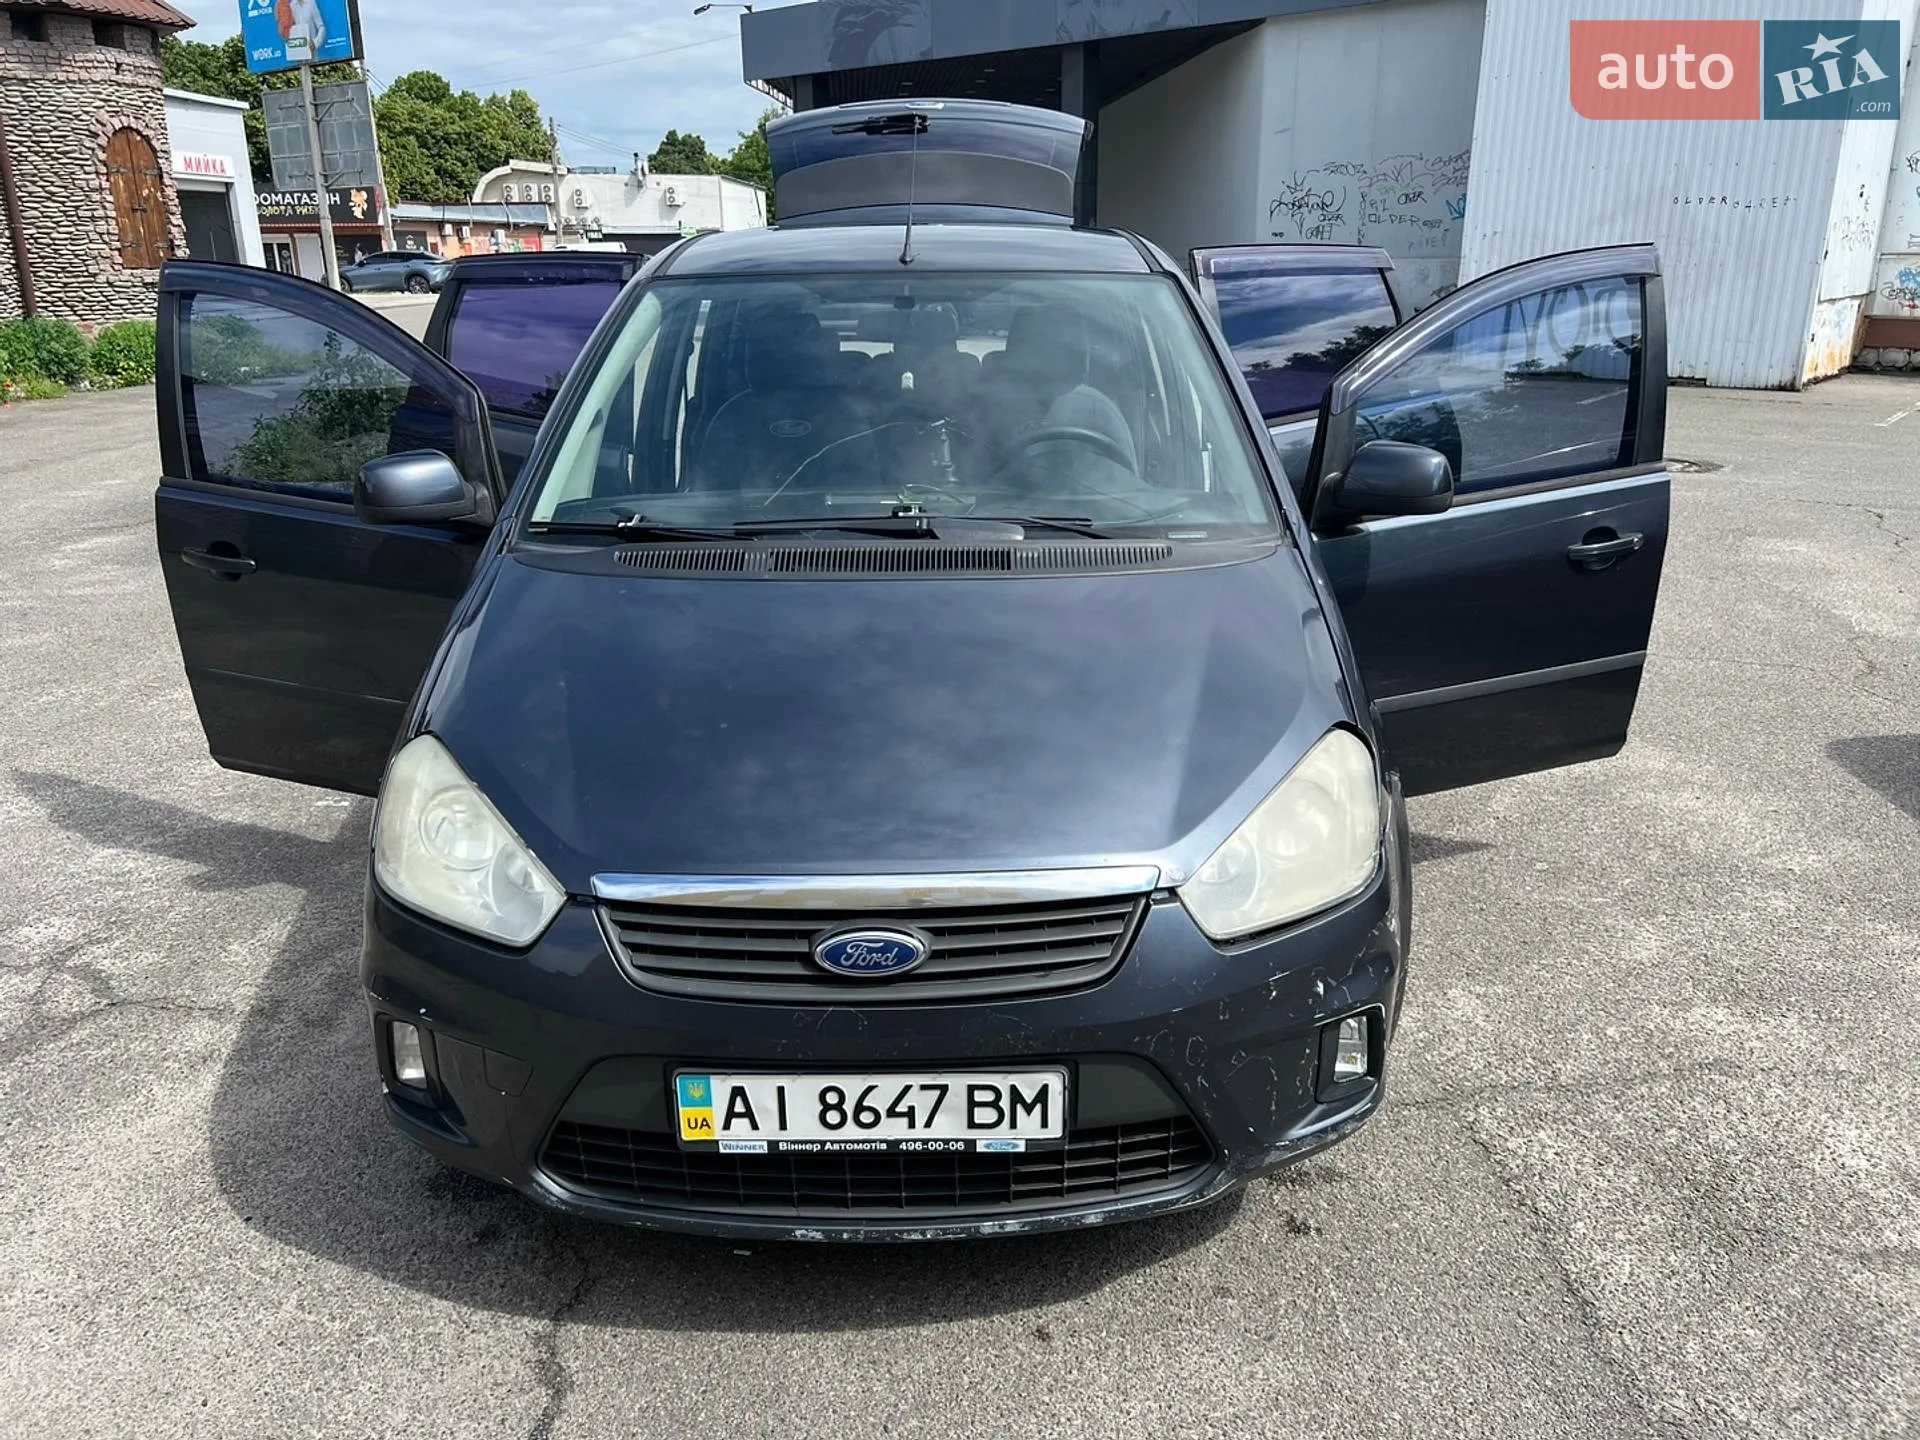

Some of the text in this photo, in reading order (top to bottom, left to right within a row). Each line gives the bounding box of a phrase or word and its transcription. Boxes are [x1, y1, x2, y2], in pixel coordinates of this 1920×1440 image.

[183, 154, 227, 175] МИЙКА
[840, 941, 899, 967] Ford
[819, 1084, 950, 1131] 8647
[687, 1117, 712, 1130] UA
[778, 1141, 965, 1152] Віннер Автомотів 496-00-06
